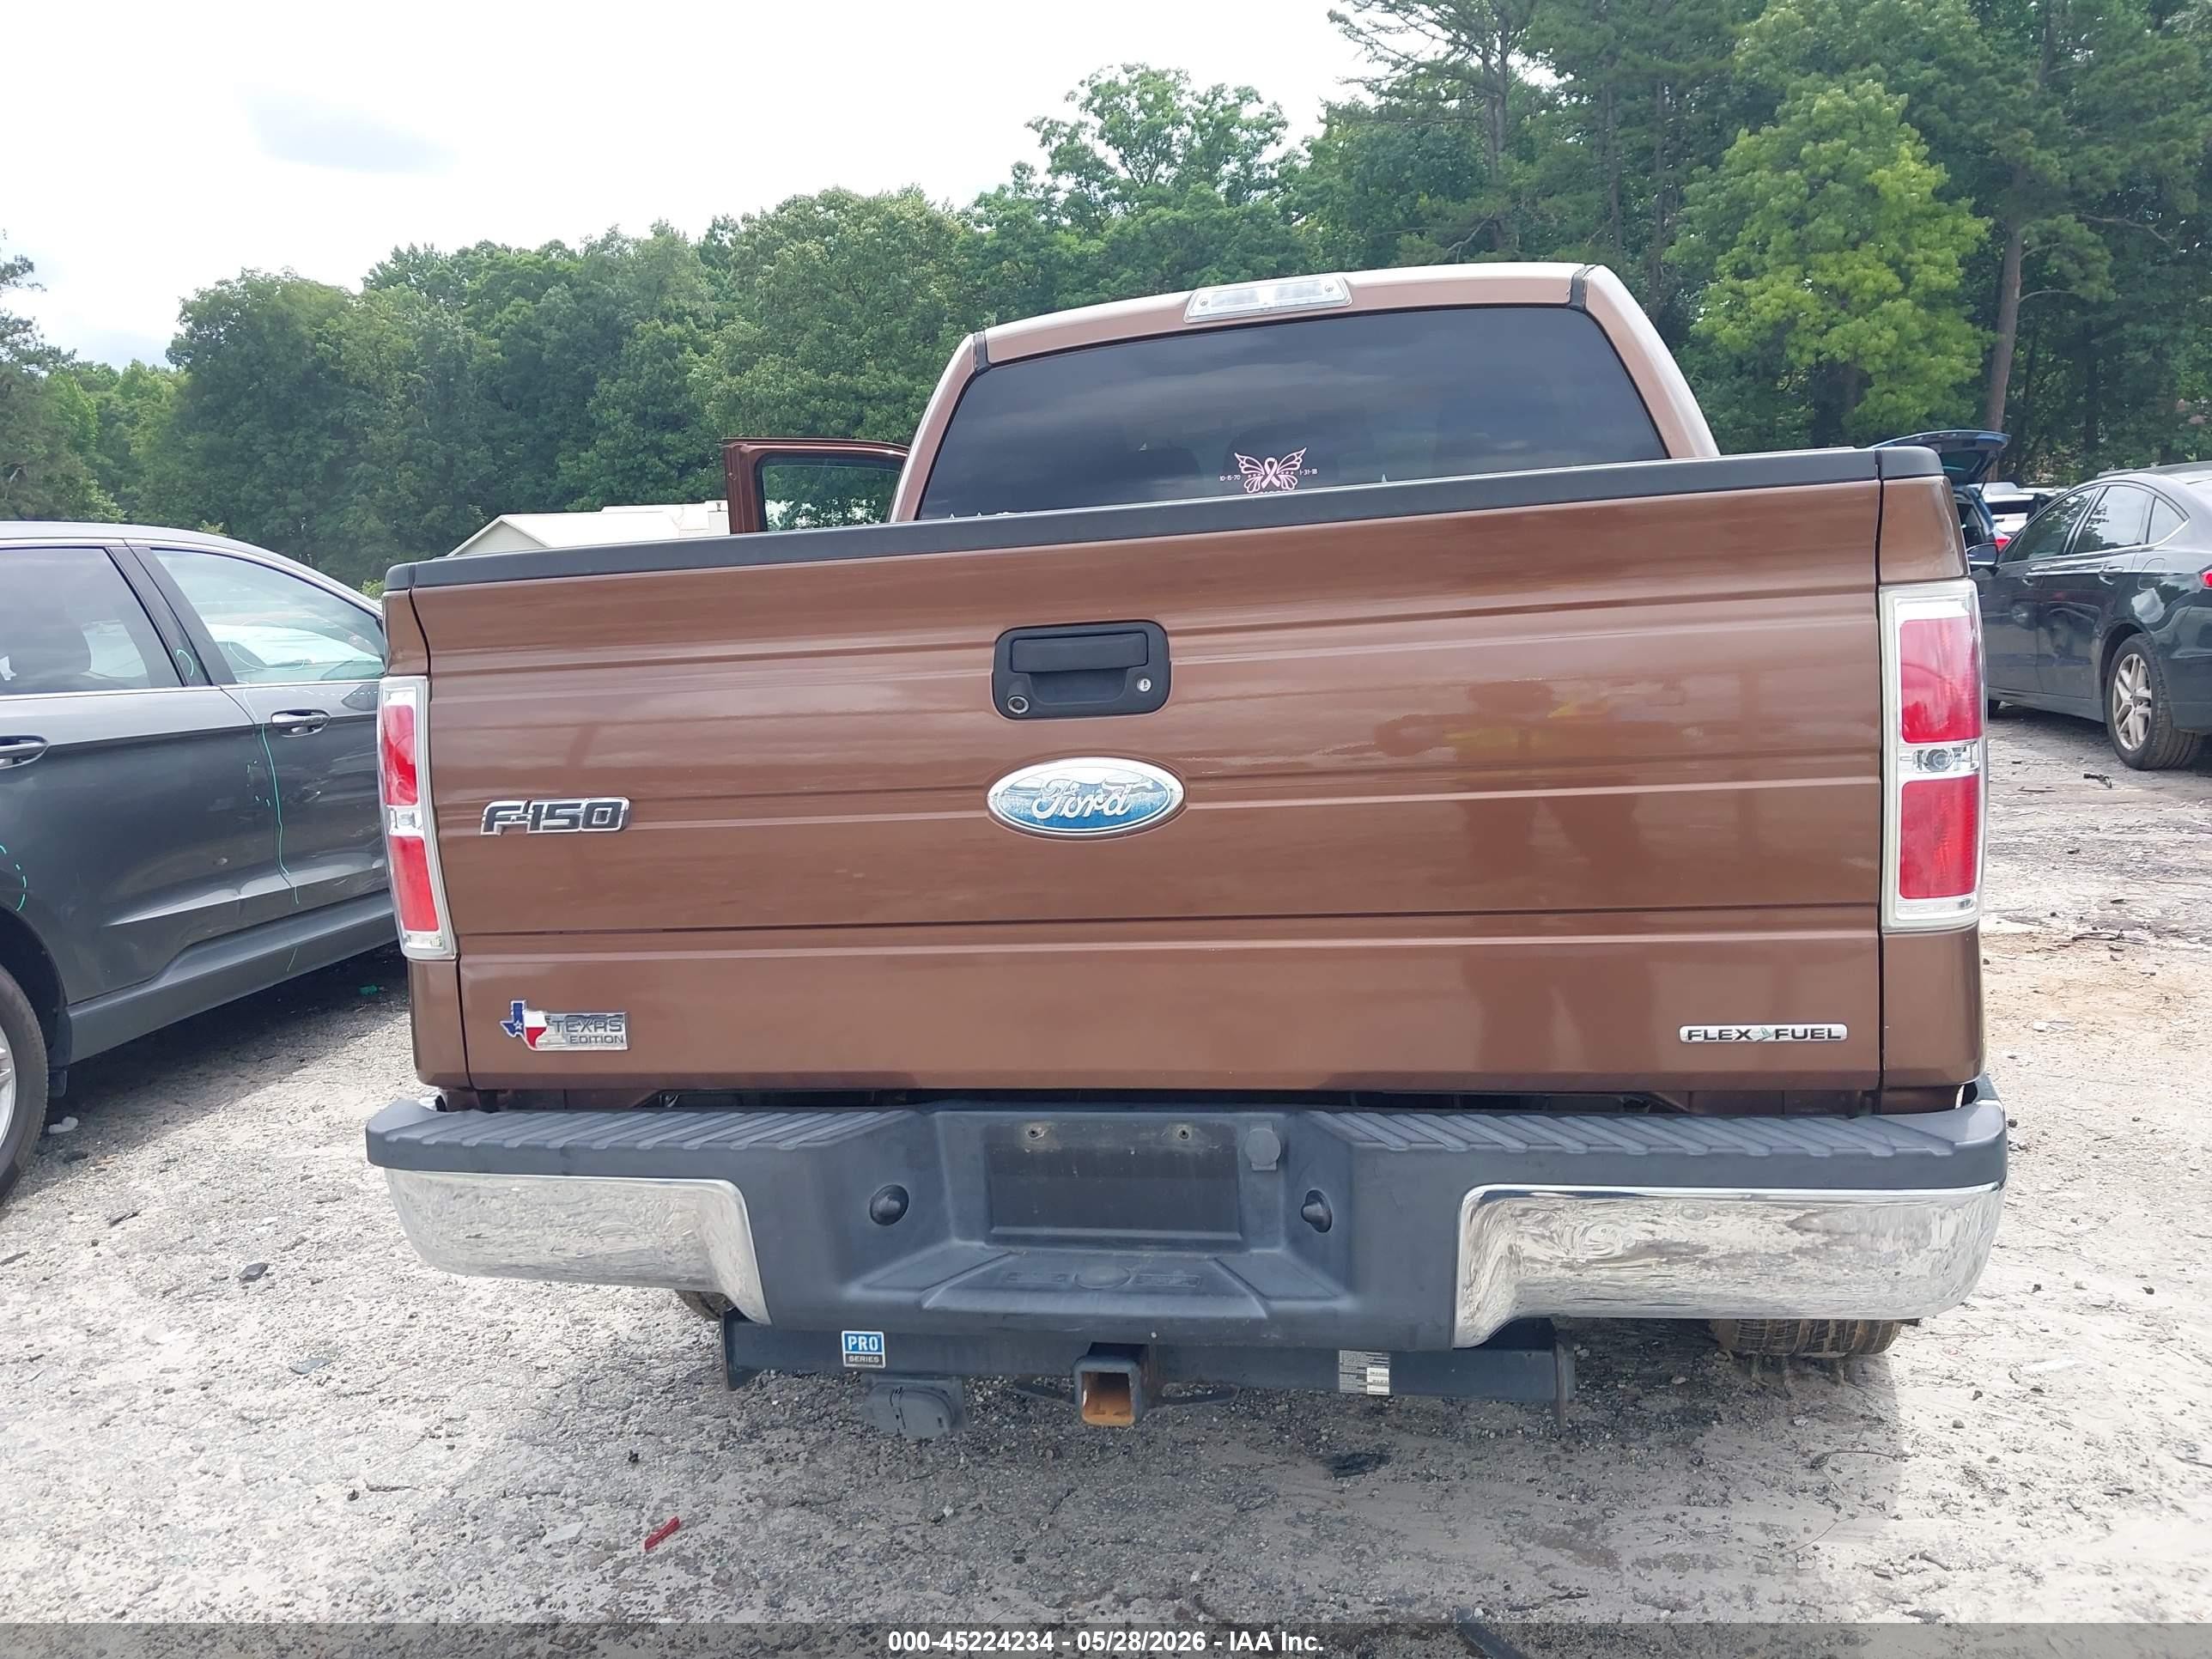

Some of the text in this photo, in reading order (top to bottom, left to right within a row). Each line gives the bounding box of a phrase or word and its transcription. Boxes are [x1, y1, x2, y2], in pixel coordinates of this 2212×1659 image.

[1030, 777, 1152, 820] Ford
[481, 797, 630, 836] F-150
[551, 1018, 623, 1033] TEXAS
[569, 1035, 624, 1044] EDITION
[1687, 1028, 1842, 1041] FLEX FUEL
[848, 1335, 878, 1351] PRO
[848, 1355, 880, 1364] SERIES
